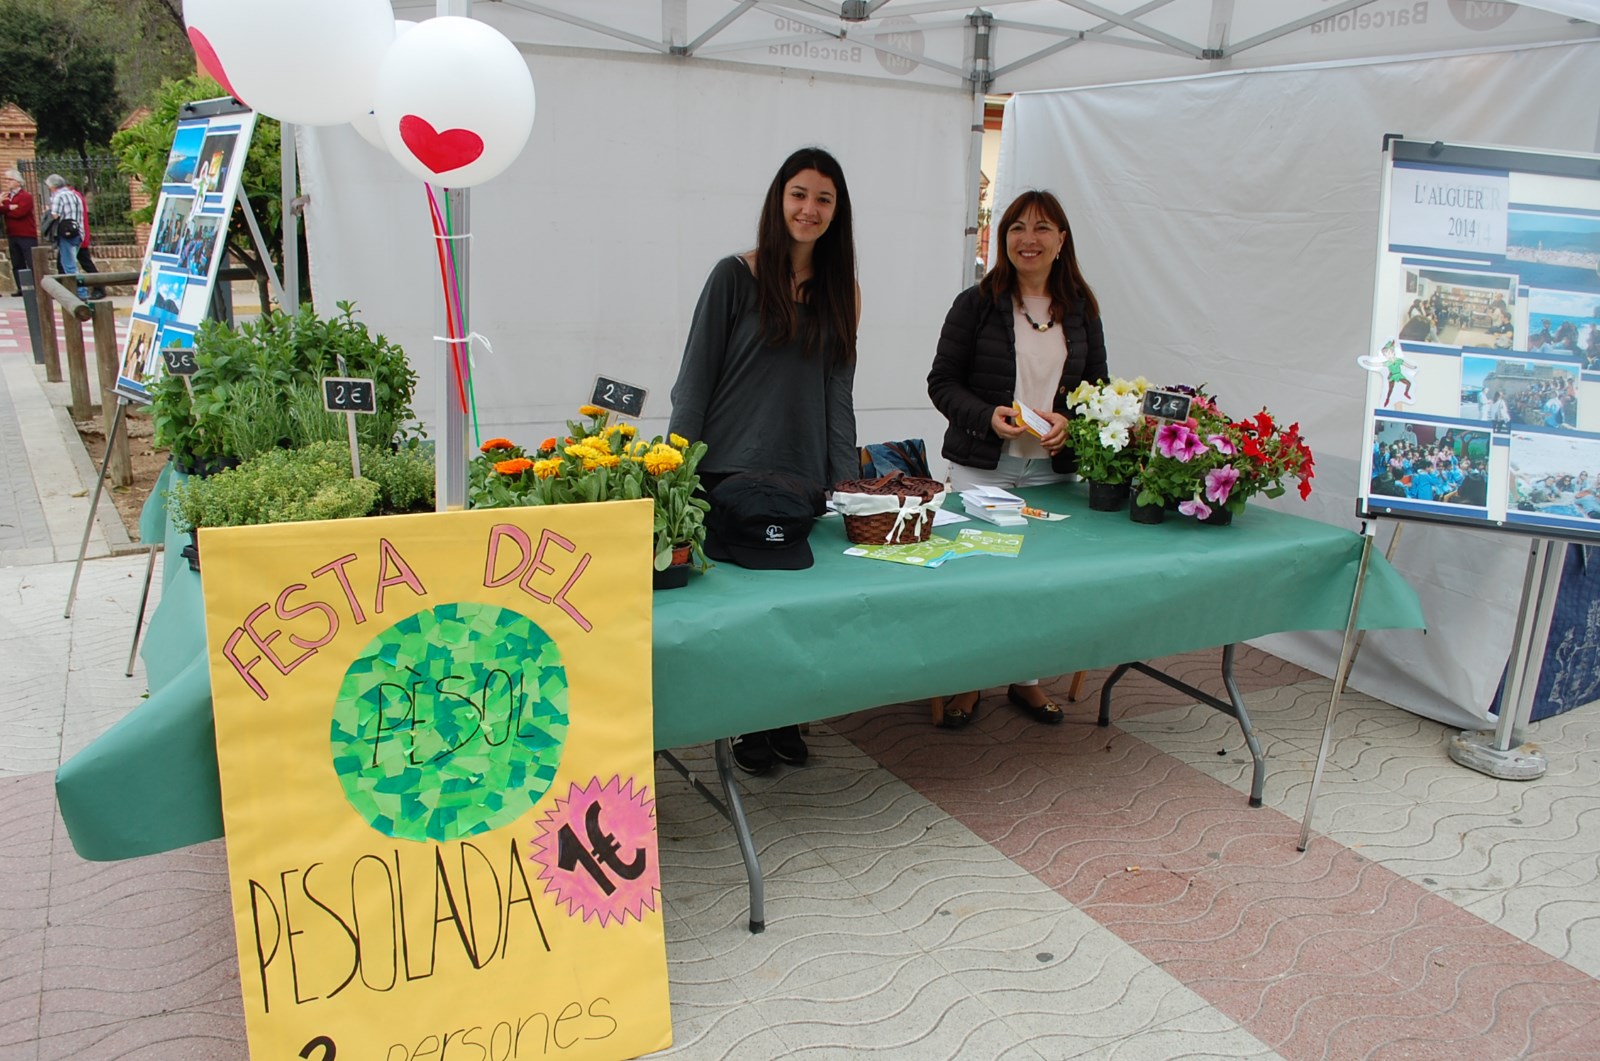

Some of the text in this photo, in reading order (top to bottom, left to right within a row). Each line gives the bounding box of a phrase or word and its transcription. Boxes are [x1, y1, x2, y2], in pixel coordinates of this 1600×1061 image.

[1414, 184, 1484, 210] L'ALGUER
[1448, 217, 1476, 238] 2014
[223, 523, 593, 702] FESTA DEL
[556, 800, 647, 897] 1€
[248, 837, 552, 1014] PESOLADA
